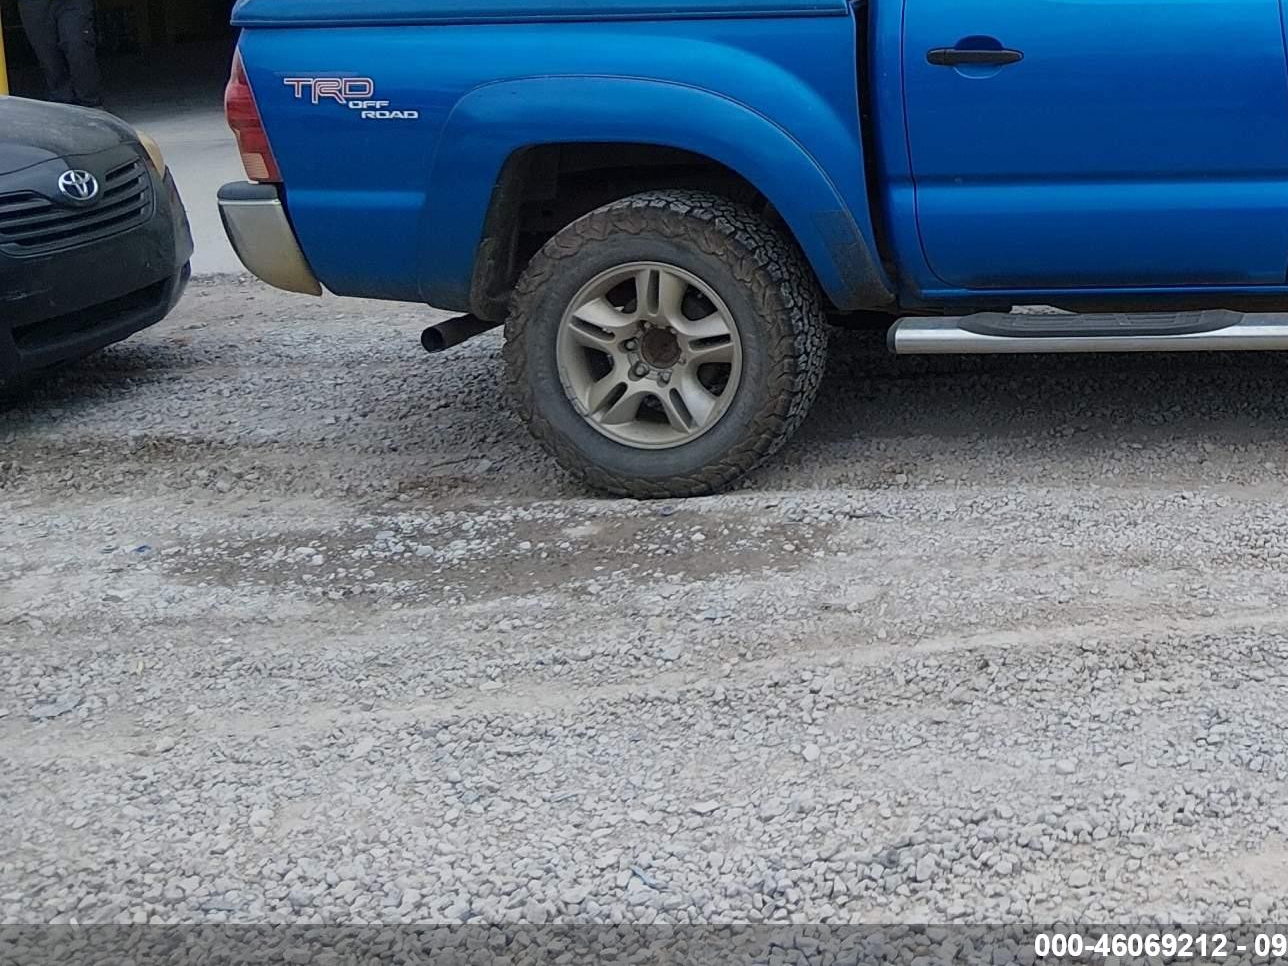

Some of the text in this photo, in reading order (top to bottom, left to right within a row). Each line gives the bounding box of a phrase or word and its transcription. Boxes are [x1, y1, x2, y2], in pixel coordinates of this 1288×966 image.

[284, 78, 374, 105] TRD
[348, 100, 390, 109] OFF
[361, 110, 419, 119] ROAD
